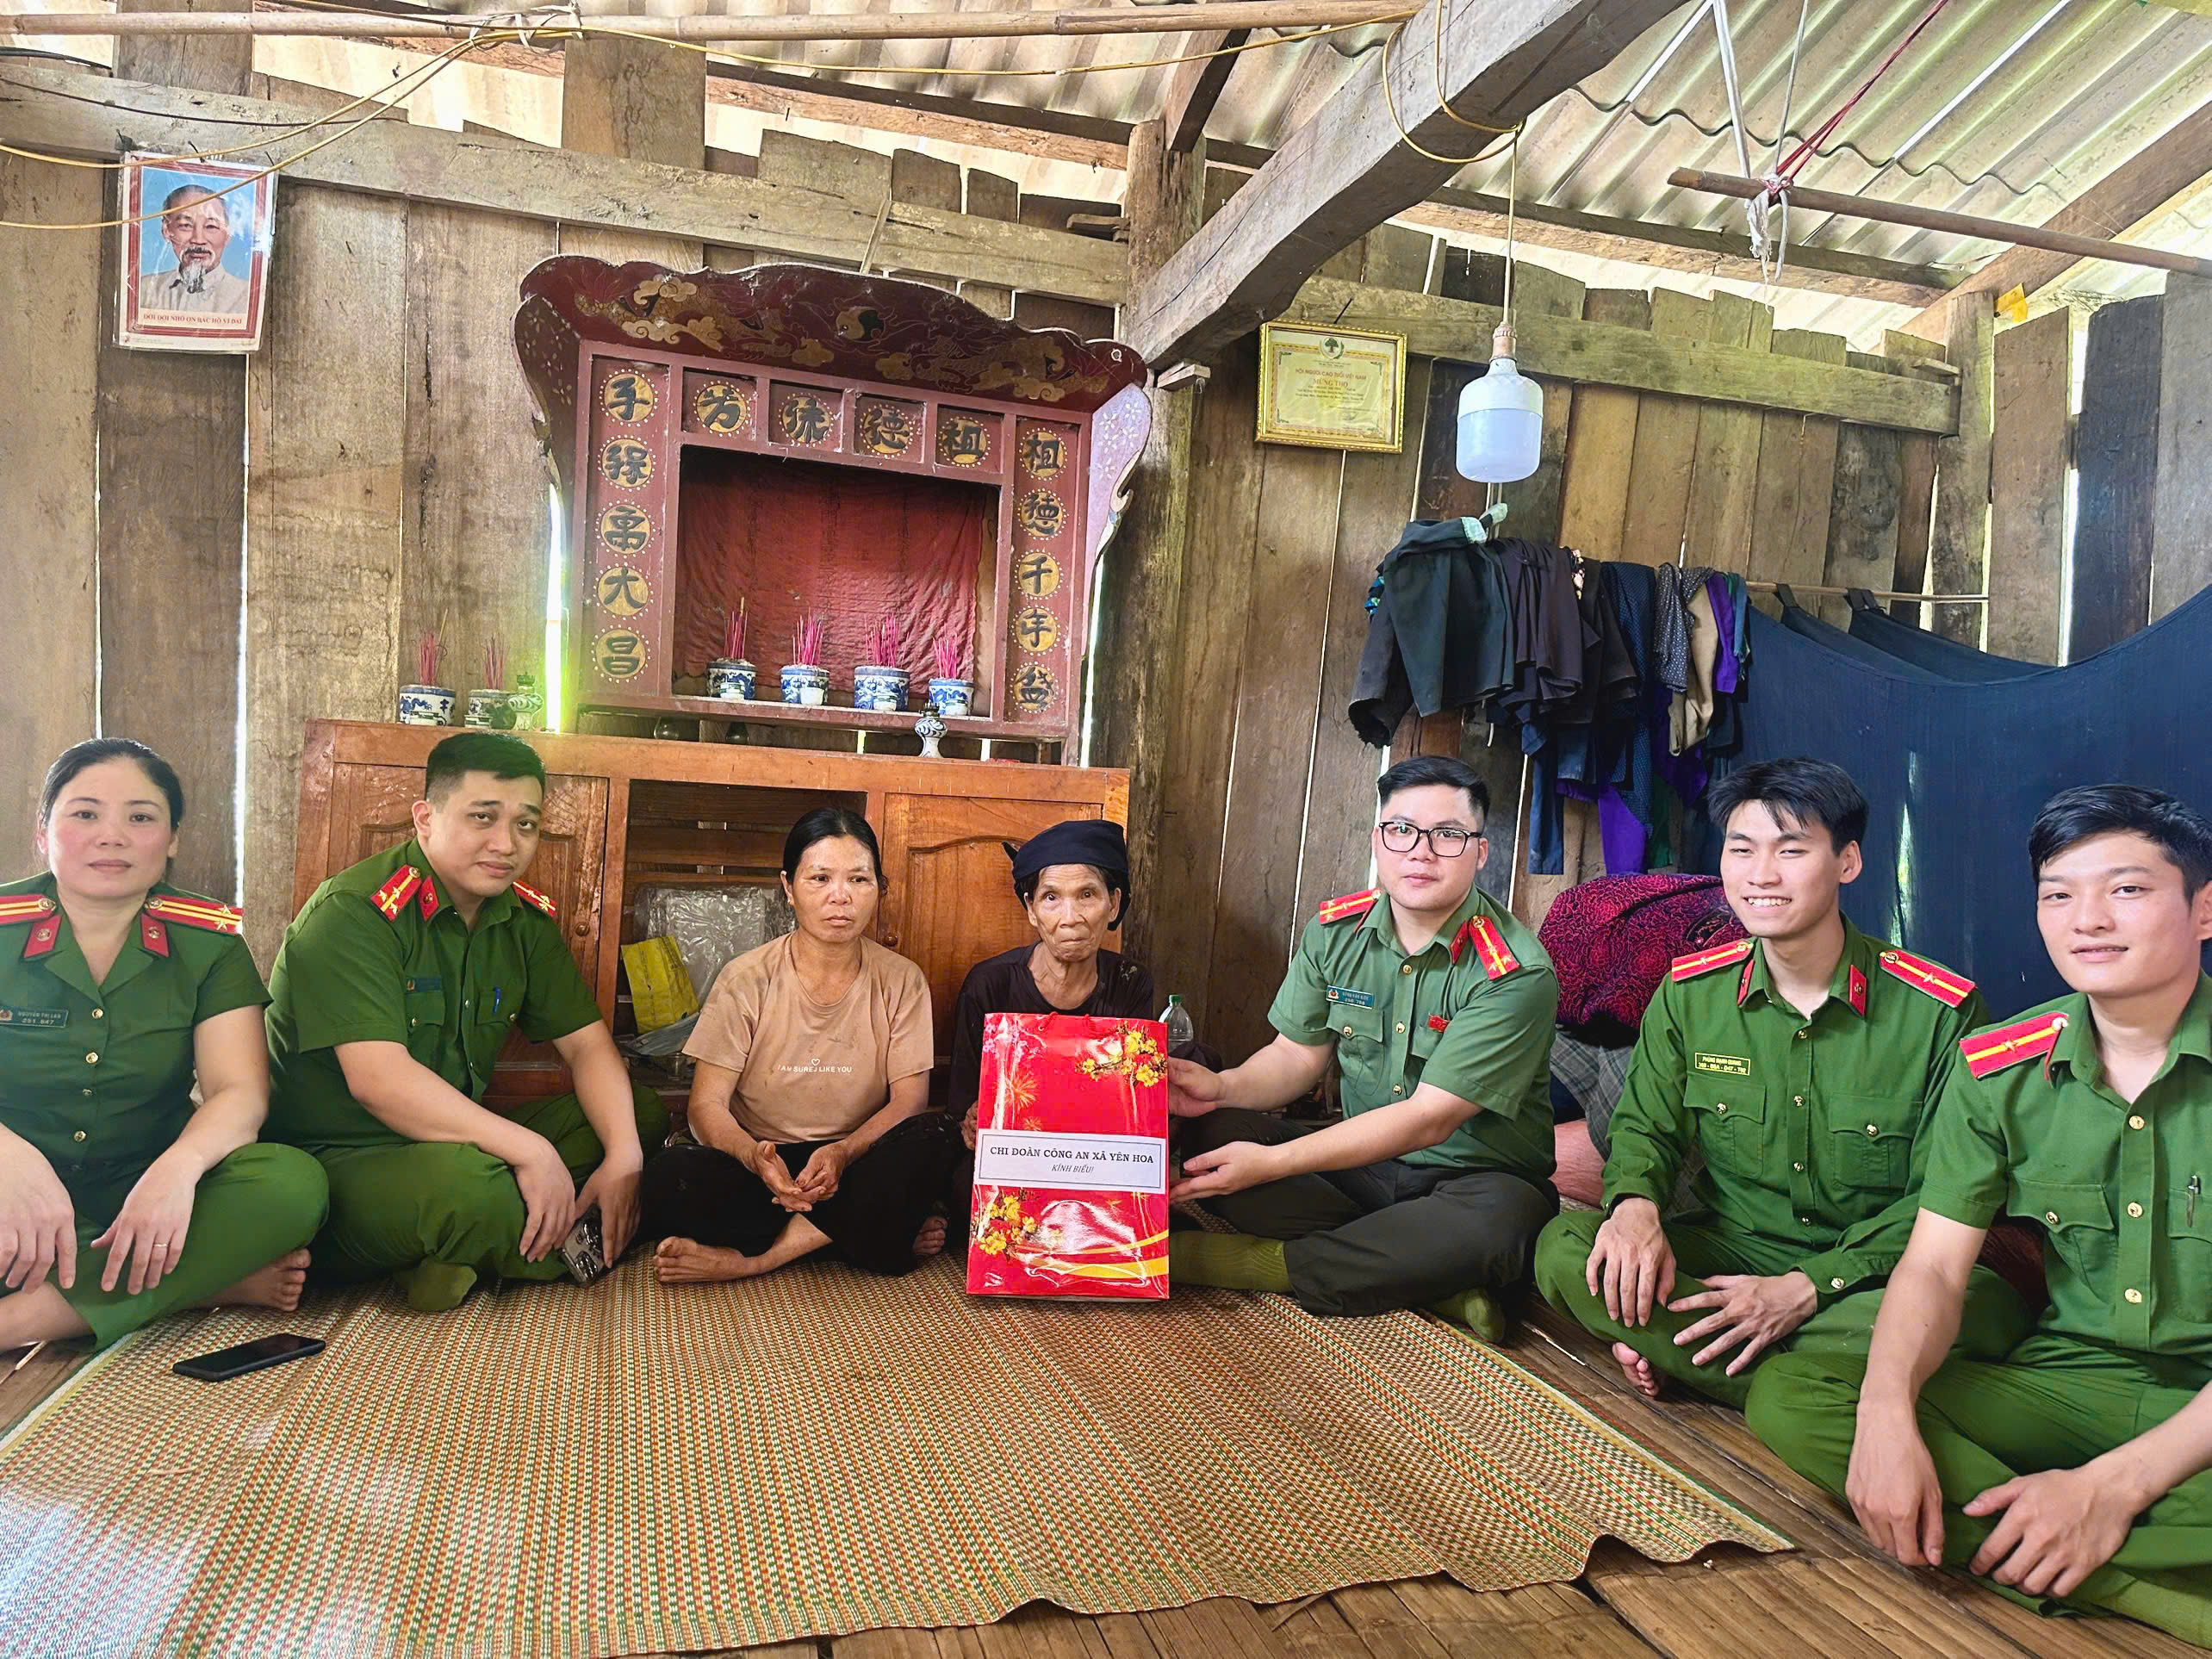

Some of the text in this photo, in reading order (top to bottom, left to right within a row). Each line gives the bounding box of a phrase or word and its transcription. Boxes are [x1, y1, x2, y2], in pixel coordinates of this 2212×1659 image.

[990, 1145, 1154, 1164] CHI ĐOÀN CÔNG AN XÃ YÊN HOA
[1051, 1163, 1072, 1172] KÍNH
